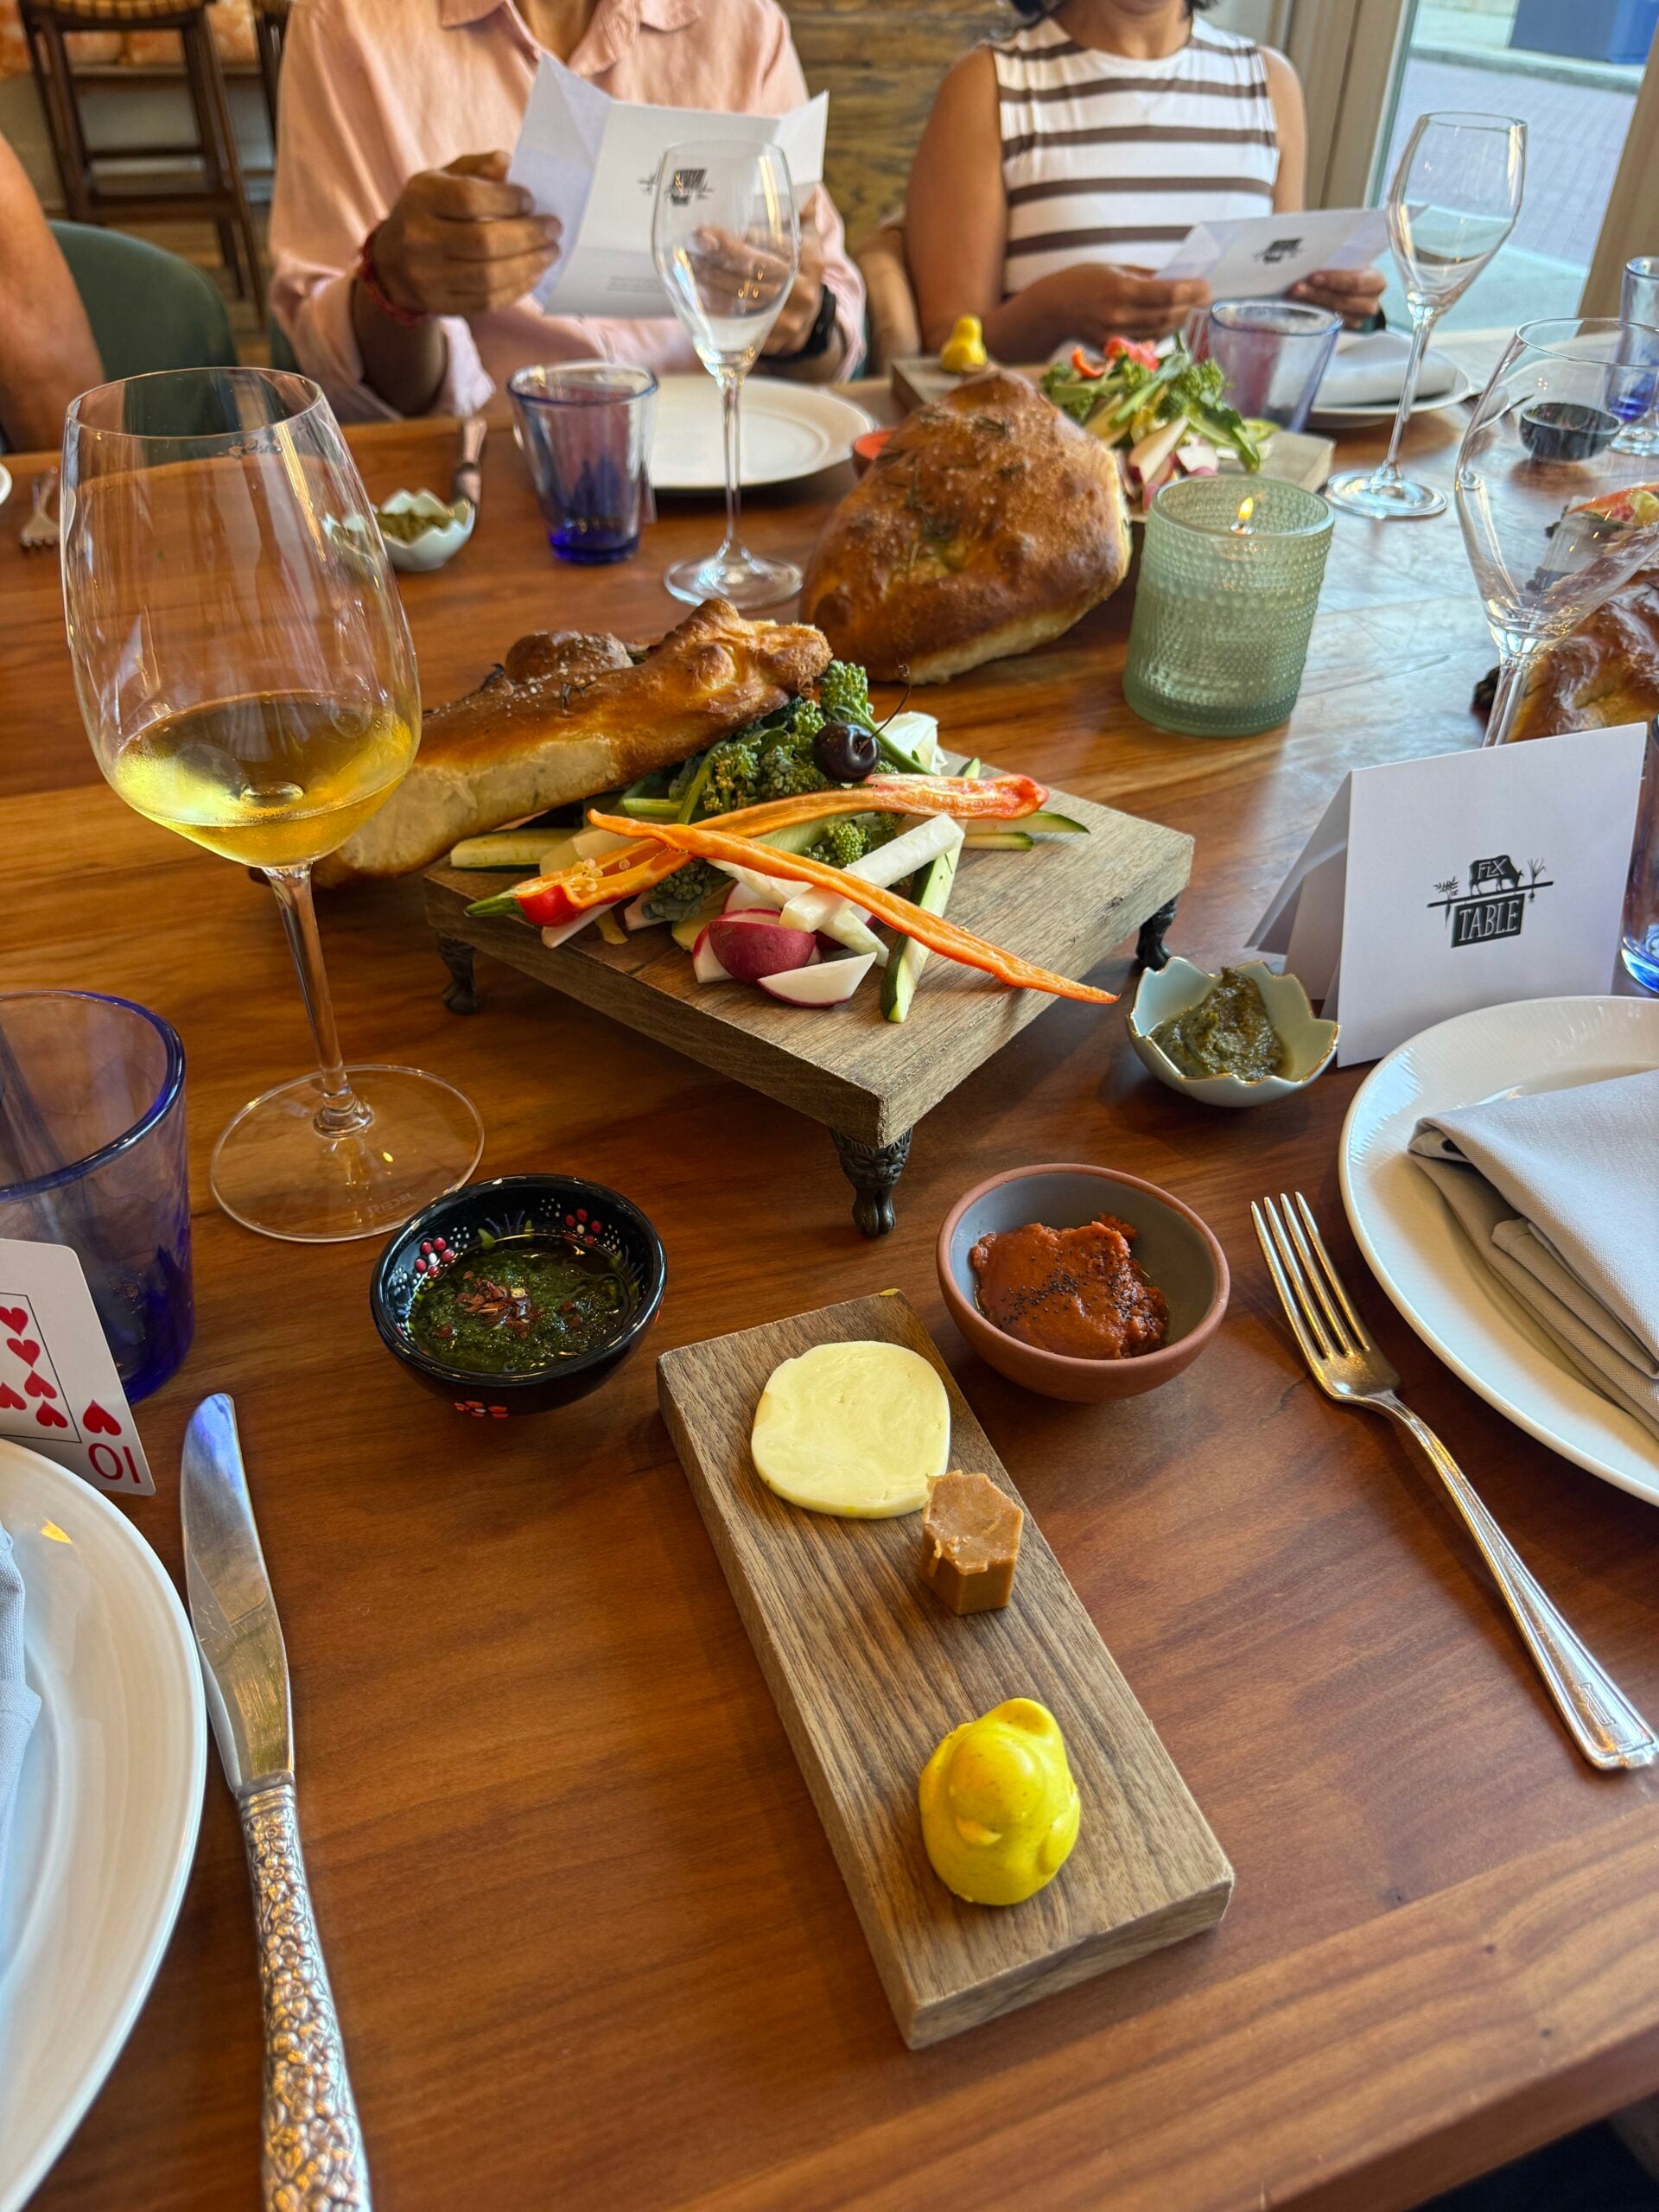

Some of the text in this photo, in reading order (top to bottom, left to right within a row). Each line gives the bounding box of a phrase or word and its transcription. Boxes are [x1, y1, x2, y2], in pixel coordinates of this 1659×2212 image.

[1477, 857, 1507, 880] FLX
[1458, 899, 1520, 942] TABLE
[88, 1442, 141, 1484] 10
